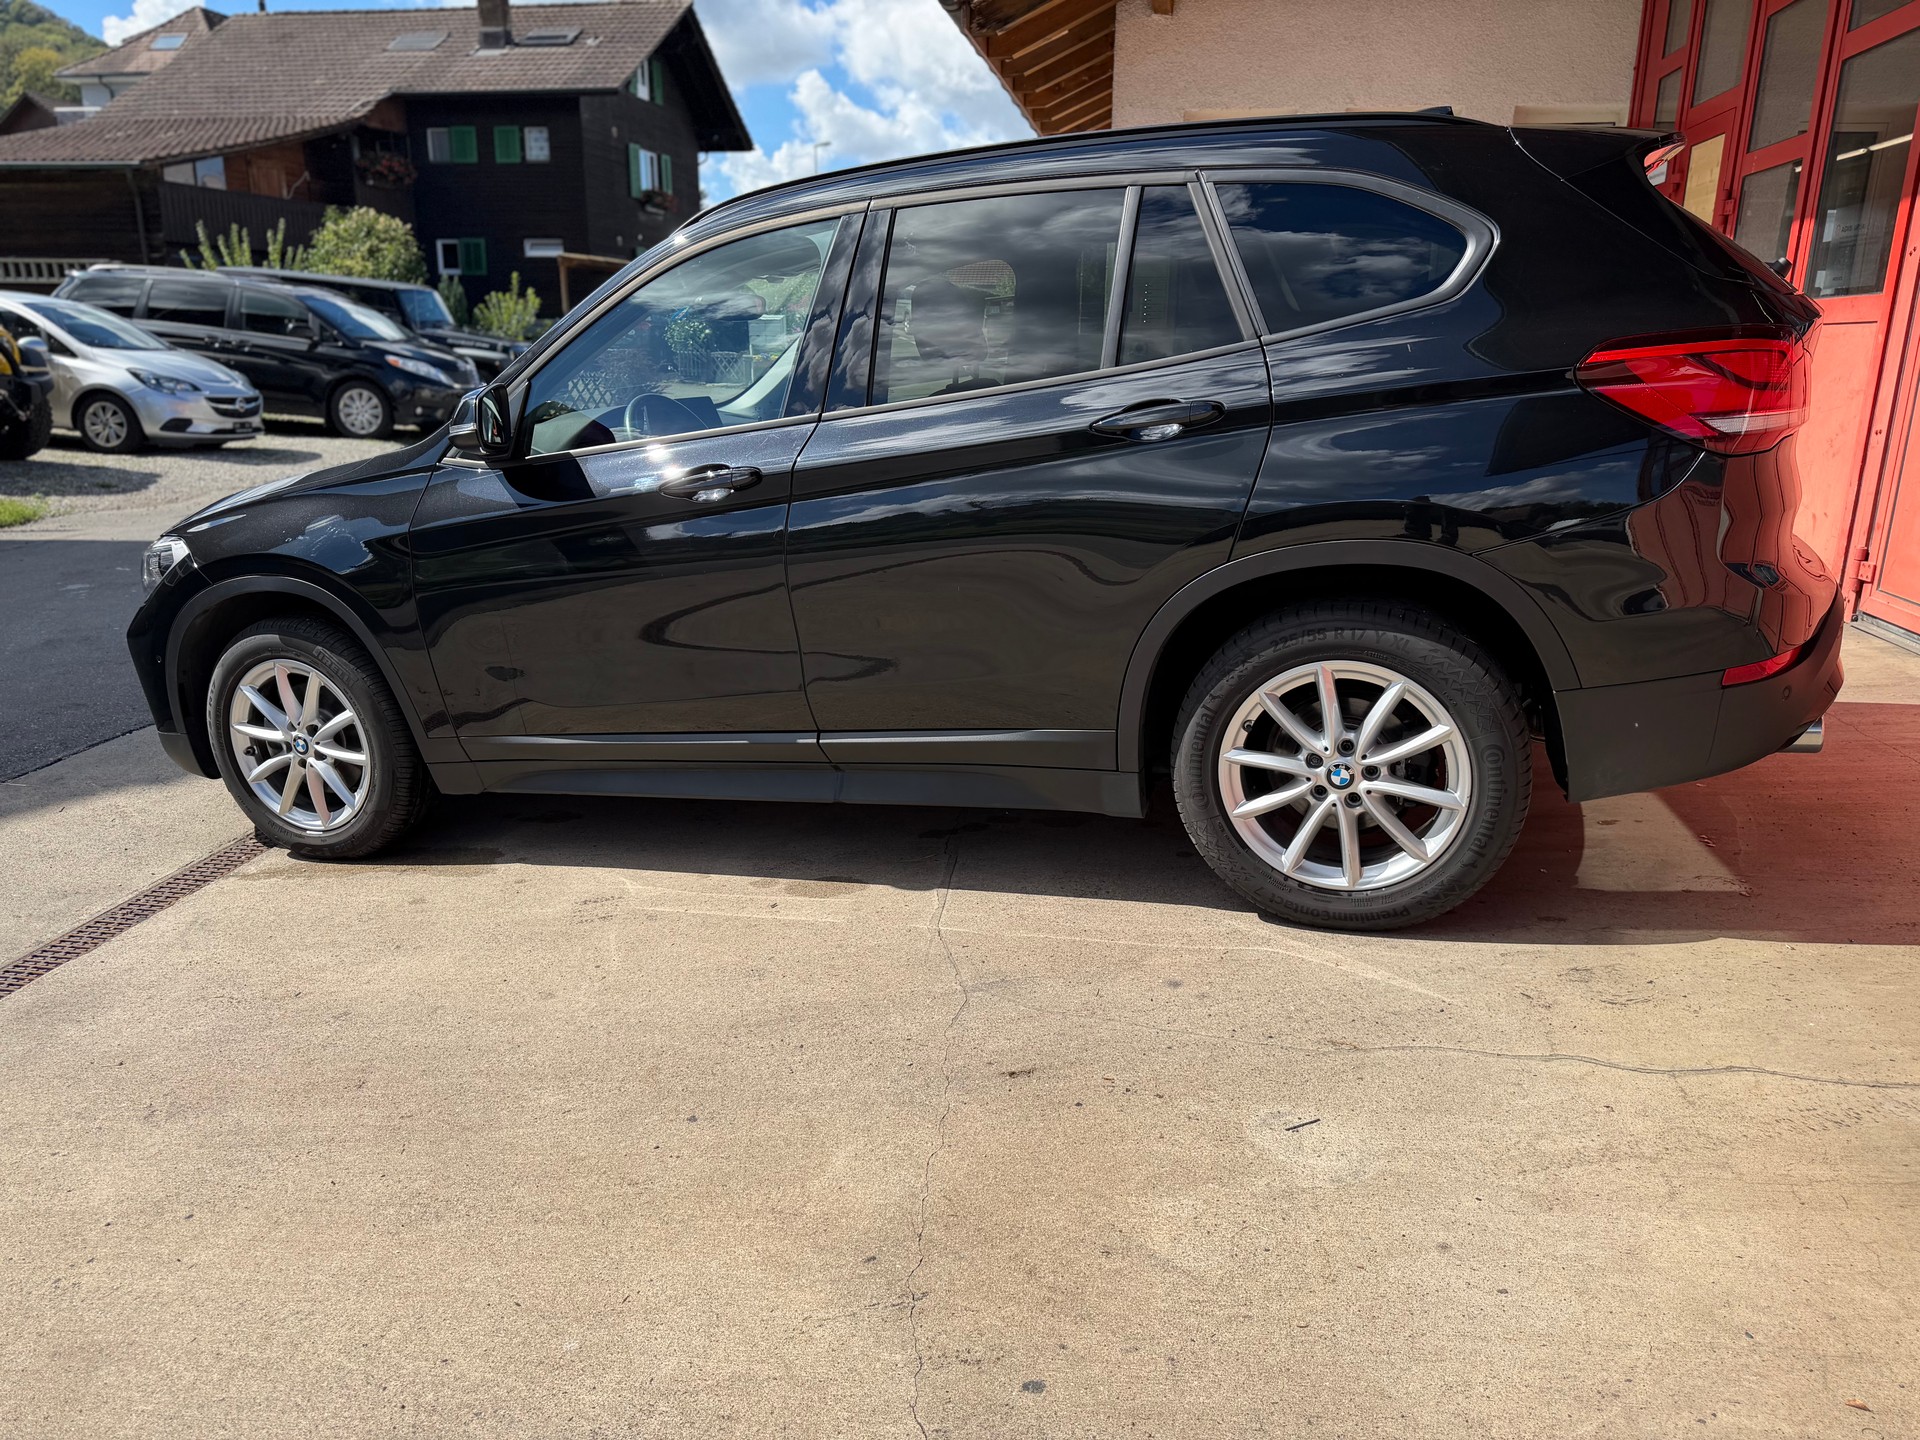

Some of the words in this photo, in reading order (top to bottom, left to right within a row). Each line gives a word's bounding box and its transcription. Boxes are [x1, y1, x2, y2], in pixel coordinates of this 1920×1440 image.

[1269, 627, 1328, 653] 225/55
[1390, 634, 1412, 655] XL
[1187, 704, 1218, 811] Continental
[1467, 743, 1509, 858] Continental
[1267, 891, 1411, 925] PremiumContact
